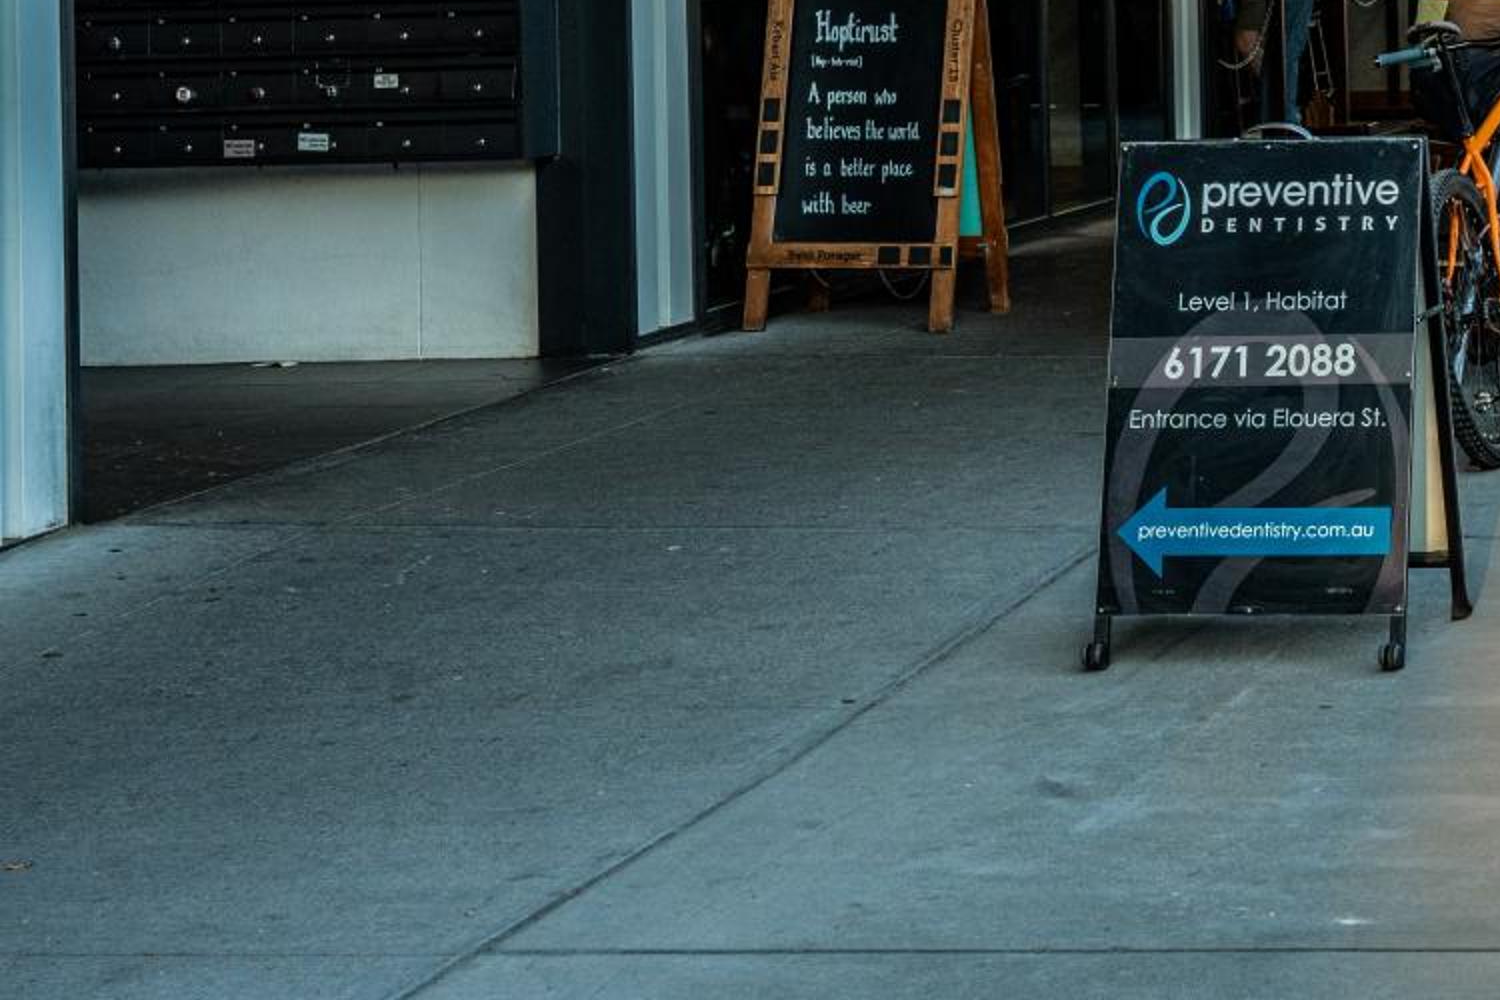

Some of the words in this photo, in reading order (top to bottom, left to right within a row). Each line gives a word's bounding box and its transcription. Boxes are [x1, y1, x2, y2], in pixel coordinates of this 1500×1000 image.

[807, 82, 820, 105] A
[827, 88, 867, 111] person
[874, 88, 897, 105] who
[806, 116, 861, 141] believes
[865, 119, 884, 141] the
[887, 120, 920, 141] world
[805, 156, 816, 177] is
[823, 162, 832, 177] a
[840, 157, 876, 178] better
[881, 159, 914, 184] place
[801, 191, 835, 215] with
[841, 193, 872, 215] beer
[1201, 173, 1400, 215] preventive
[1201, 215, 1399, 233] DENTISTRY
[1178, 291, 1236, 311] Level
[1243, 292, 1259, 314] 1,
[1266, 289, 1348, 311] Habitat
[1163, 345, 1249, 380] 6171
[1264, 342, 1357, 378] 2088
[1128, 409, 1228, 430] Entrance
[1235, 410, 1266, 428] via
[1273, 407, 1355, 428] Elouera
[1361, 407, 1387, 428] St.
[1137, 521, 1375, 542] preventivedentistry.com.au
